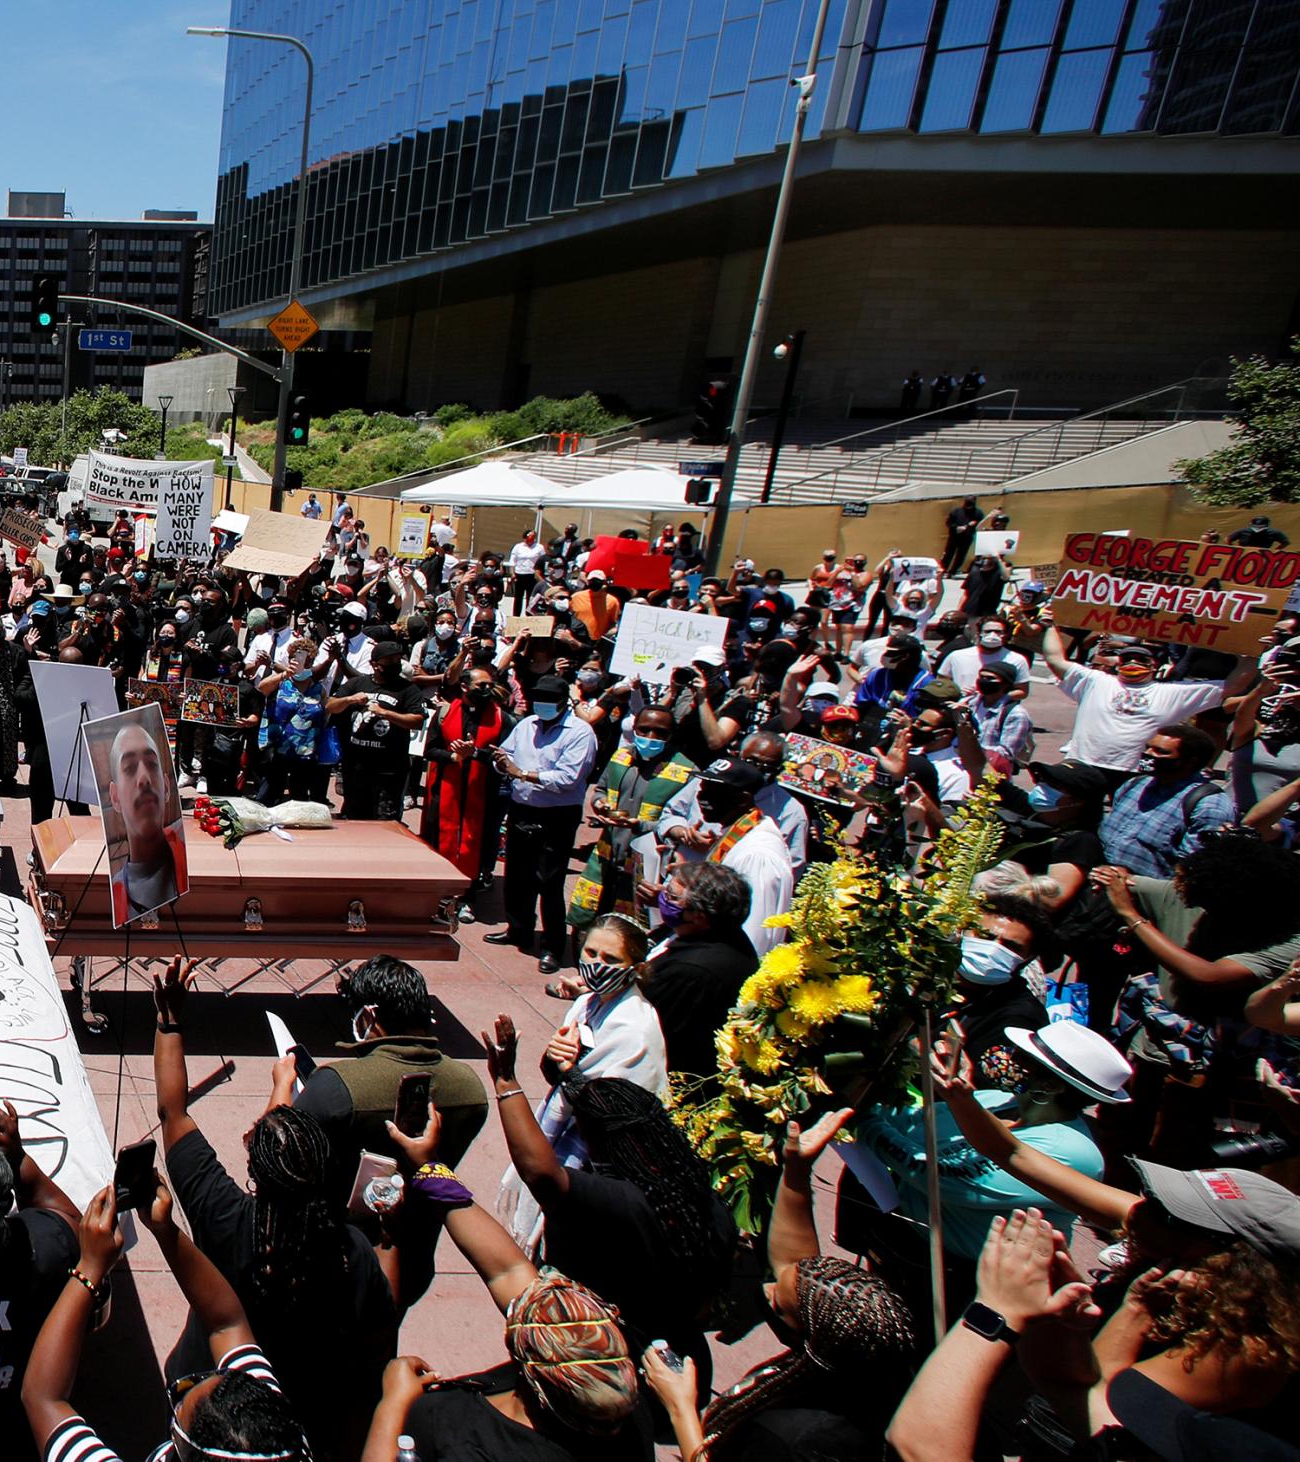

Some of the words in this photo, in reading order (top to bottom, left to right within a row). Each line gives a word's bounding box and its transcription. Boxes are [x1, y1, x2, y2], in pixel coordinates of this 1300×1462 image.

[87, 332, 104, 346] 1st
[109, 335, 125, 346] St
[92, 468, 118, 486] Stop
[122, 476, 145, 489] the
[119, 466, 141, 476] Revolt
[143, 469, 170, 478] Against
[89, 480, 125, 499] Black
[170, 476, 202, 491] HOW
[164, 491, 204, 504] MANY
[166, 504, 201, 517] WERE
[5, 510, 46, 537] PROSECUTE
[172, 516, 196, 529] NOT
[1, 524, 20, 539] KILLER
[19, 532, 36, 547] COPS
[173, 529, 193, 541] ON
[156, 540, 208, 557] CAMERA
[1066, 533, 1198, 574] GEORGE
[1108, 566, 1197, 588] CREATED
[1202, 577, 1222, 592] A
[1053, 568, 1268, 623] MOVEMENT
[1115, 605, 1160, 618] NOT
[635, 607, 682, 636] Black
[1080, 604, 1230, 647] MOMENT
